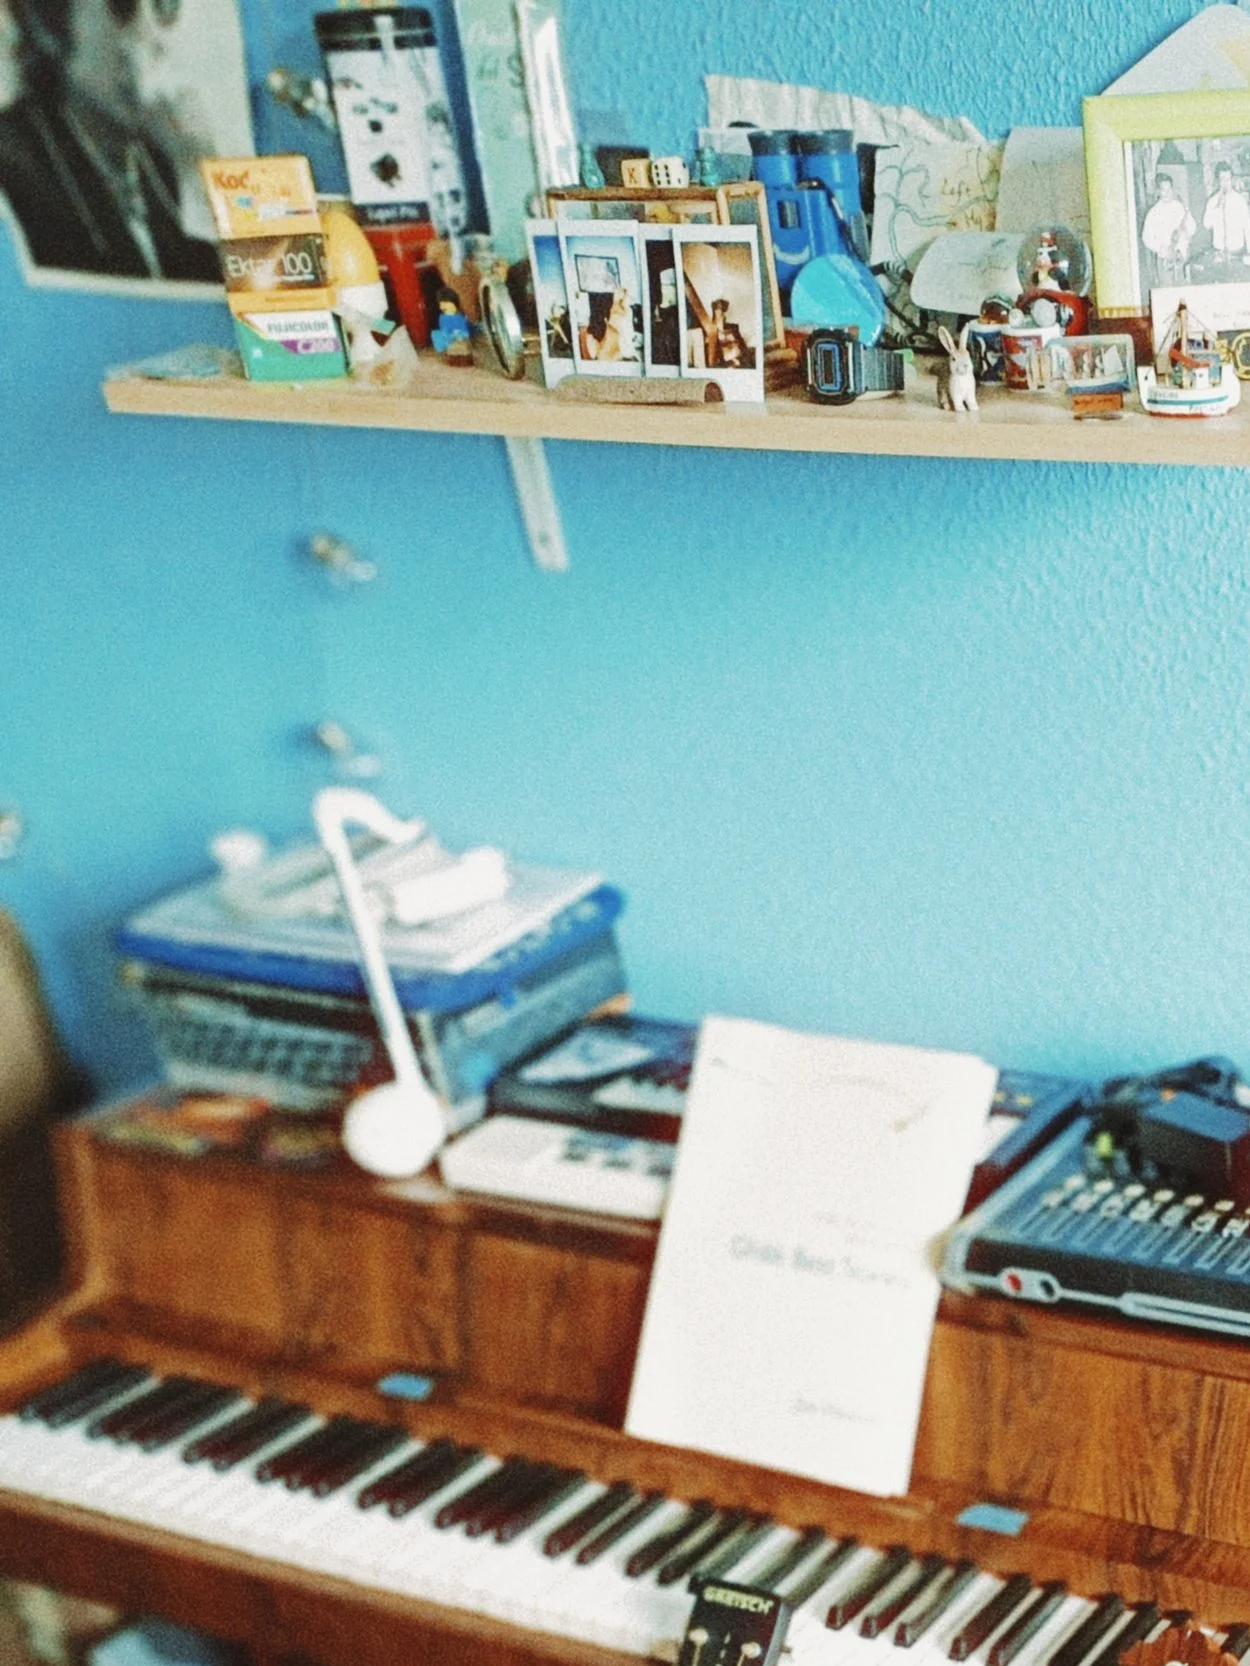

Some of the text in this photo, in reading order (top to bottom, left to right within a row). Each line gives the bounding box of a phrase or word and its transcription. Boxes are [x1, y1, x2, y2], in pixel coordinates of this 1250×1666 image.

[625, 167, 638, 184] K
[282, 252, 313, 273] 100
[702, 1586, 774, 1614] GRETSCH
